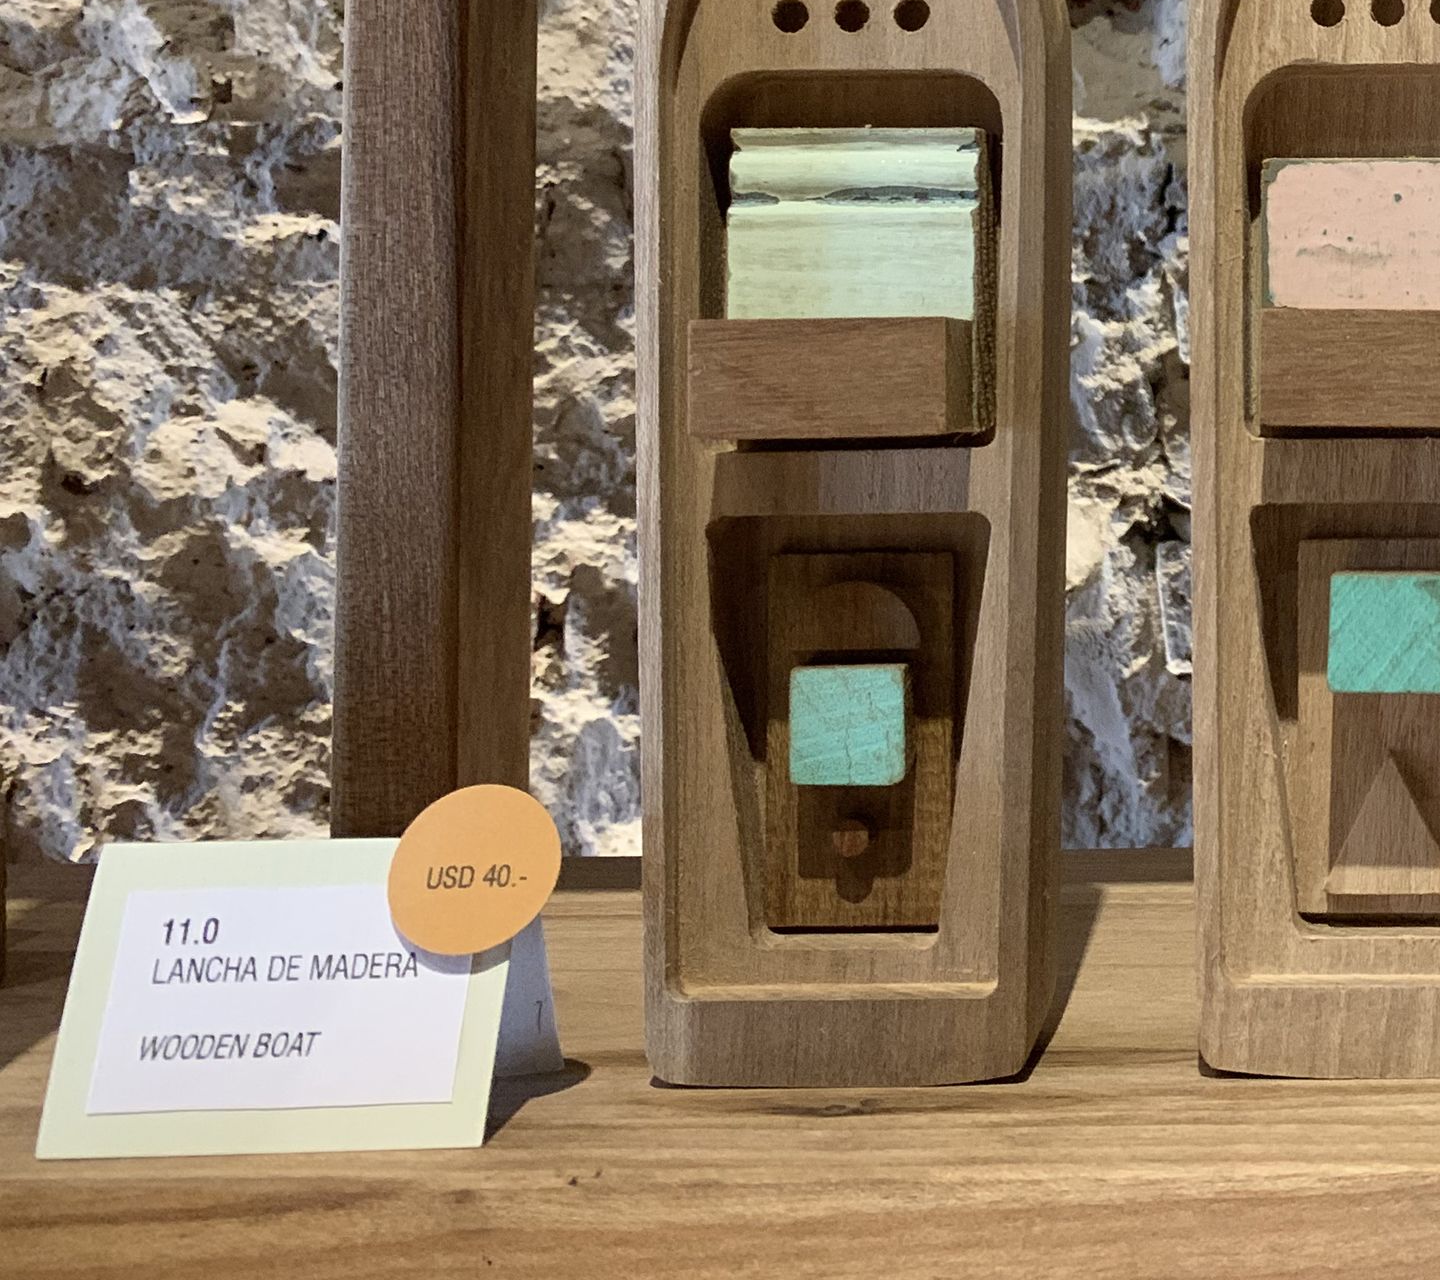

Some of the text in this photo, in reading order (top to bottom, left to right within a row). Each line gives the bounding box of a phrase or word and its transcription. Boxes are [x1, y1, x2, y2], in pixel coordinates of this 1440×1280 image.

[426, 864, 528, 890] USD 40.-
[161, 918, 220, 946] 11.0
[152, 952, 419, 985] LANCHA DE MADERA
[139, 1032, 321, 1062] WOODEN BOAT
